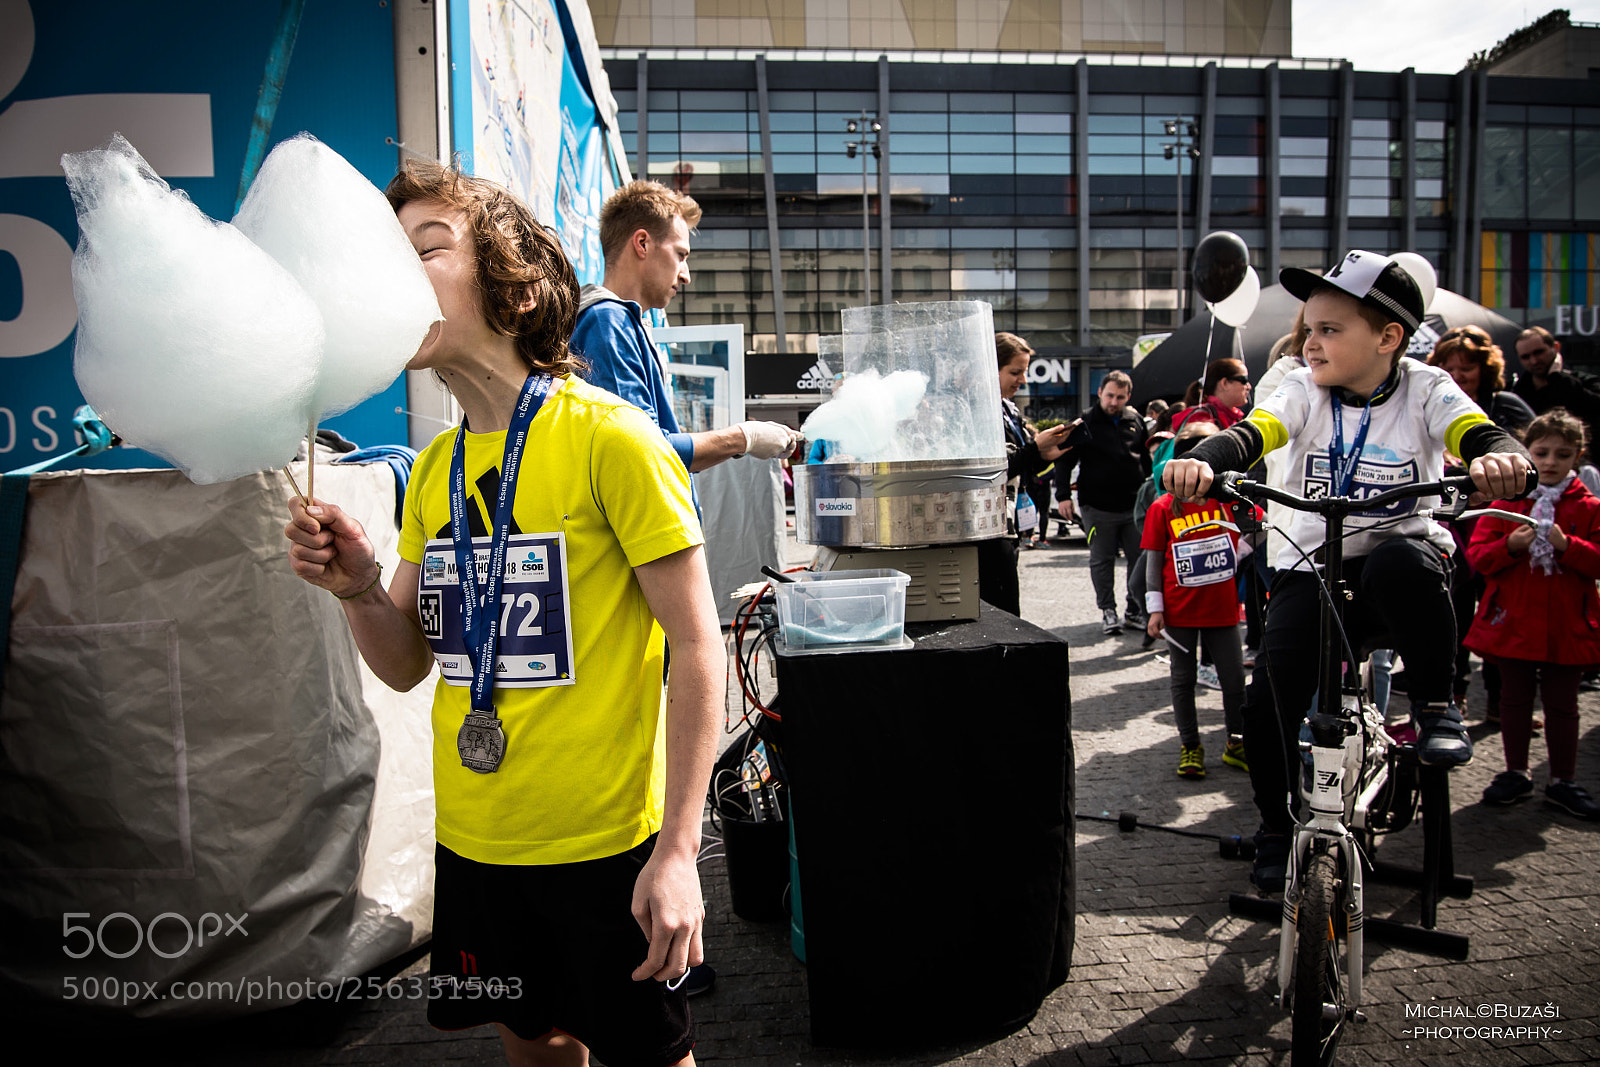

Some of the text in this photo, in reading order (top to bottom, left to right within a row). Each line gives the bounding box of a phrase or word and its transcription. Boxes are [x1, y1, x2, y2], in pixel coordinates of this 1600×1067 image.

[796, 378, 836, 390] adida
[517, 392, 532, 412] ČSOB
[508, 430, 525, 482] MARATHON 2018
[1376, 473, 1394, 481] 2018
[825, 502, 853, 511] slovakia
[493, 540, 505, 577] MARATHON
[1204, 551, 1228, 569] 405
